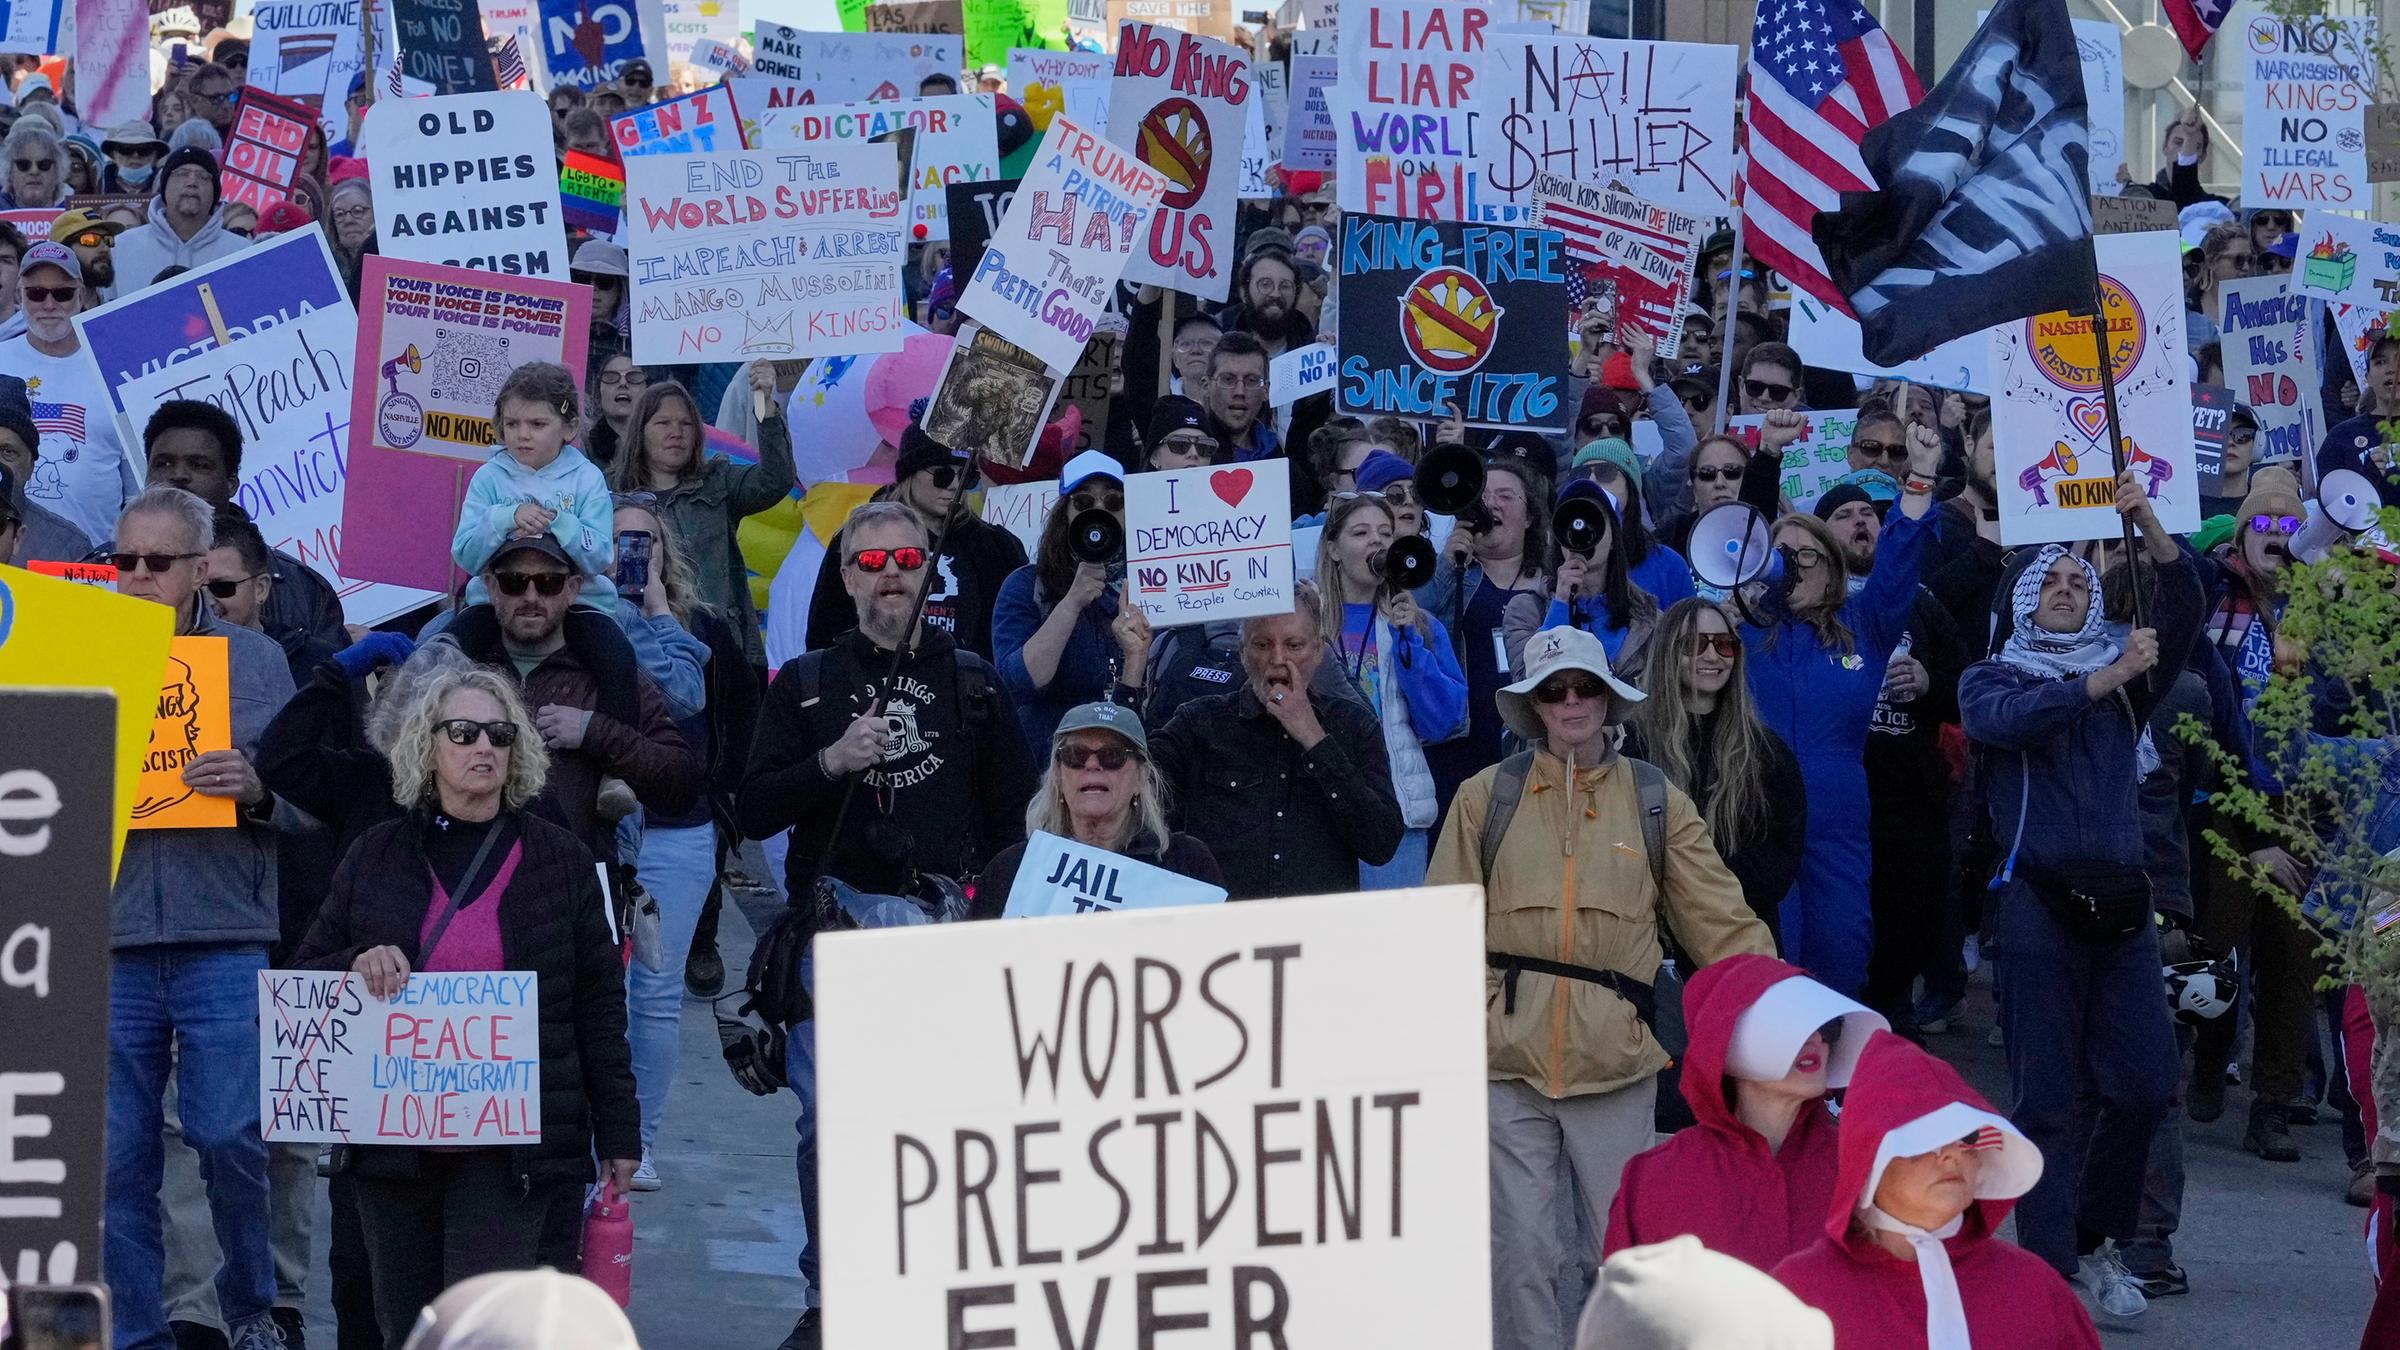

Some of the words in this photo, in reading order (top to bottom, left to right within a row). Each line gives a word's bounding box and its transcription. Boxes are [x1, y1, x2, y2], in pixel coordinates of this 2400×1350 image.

[431, 15, 461, 42] NO
[1370, 8, 1488, 52] LIAR
[2282, 23, 2338, 53] NO
[762, 37, 801, 58] MAKE
[1113, 24, 1170, 78] NO
[1171, 33, 1249, 105] KING
[81, 62, 147, 78] FAMES
[1368, 61, 1474, 108] LIAR
[2256, 60, 2360, 82] NARCISSISTIC
[2265, 82, 2358, 112] KINGS
[239, 108, 303, 151] END
[418, 109, 495, 136] OLD
[616, 103, 682, 147] GEN
[691, 94, 714, 125] Z
[804, 110, 947, 140] DICTATOR
[1352, 111, 1463, 156] WORL
[2281, 117, 2328, 143] NO
[232, 143, 284, 183] OIL
[393, 155, 535, 189] HIPPIES
[687, 160, 763, 192] END
[776, 156, 840, 182] THE
[1046, 154, 1062, 174] A
[1055, 117, 1167, 206] TRUMP?
[2263, 148, 2339, 168] ILLEGAL
[566, 182, 616, 203] RIGHTS
[567, 170, 616, 190] LGBTQ+
[1366, 156, 1464, 223] FIR
[2260, 172, 2352, 203] WARS
[392, 202, 548, 237] AGAINST
[640, 194, 767, 233] WORLD
[1538, 173, 1573, 203] SCHOOL
[1576, 185, 1600, 211] KIDS
[1649, 208, 1667, 230] DIE
[1668, 212, 1696, 235] HERE
[2100, 198, 2157, 213] ACTION
[1027, 191, 1137, 253] HA!
[637, 236, 796, 286] IMPEACH
[813, 231, 901, 260] ARREST
[1149, 208, 1217, 278] U.S.
[1342, 215, 1566, 285] KING-FREE
[1605, 231, 1624, 250] OR
[1623, 241, 1642, 261] IN
[1641, 251, 1675, 283] IRAN
[387, 289, 431, 306] YOUR
[434, 296, 481, 313] VOICE
[483, 303, 500, 316] IS
[503, 304, 563, 325] POWER
[388, 276, 433, 294] YOUR
[435, 283, 482, 300] VOICE
[484, 290, 501, 301] IS
[504, 291, 564, 312] POWER
[639, 288, 744, 323] MANGO
[2223, 283, 2307, 334] America
[385, 302, 430, 319] YOUR
[433, 308, 480, 326] VOICE
[482, 315, 499, 329] IS
[501, 317, 562, 338] POWER
[1041, 288, 1094, 344] GOOD
[2039, 316, 2133, 337] NASHVLLE
[678, 326, 721, 355] NO
[2248, 335, 2288, 365] Has
[1299, 366, 1324, 386] NO
[1301, 350, 1327, 369] NO
[387, 396, 418, 413] SINGING
[1342, 355, 1461, 419] SINCE
[1469, 372, 1559, 423] 1776
[2247, 372, 2298, 406] NO
[382, 422, 419, 445] RESISTANCE
[383, 412, 420, 424] NASHVILLE
[426, 413, 450, 437] NO
[453, 417, 497, 445] KING
[239, 411, 350, 522] onvict
[1166, 479, 1180, 514] I
[2059, 483, 2082, 506] NO
[2086, 480, 2115, 505] KIN
[1136, 515, 1267, 553] DEMOCRACY
[1138, 567, 1168, 587] NO
[1177, 559, 1231, 585] KING
[1248, 555, 1268, 580] IN
[922, 605, 957, 617] MEN'S
[882, 675, 936, 705] INGS
[1193, 667, 1230, 683] PRESS
[1887, 712, 1909, 727] ICE
[1046, 852, 1123, 904] JAIL
[272, 976, 363, 1017] KINGS
[388, 974, 532, 1008] DEMOCRACY
[275, 1017, 353, 1055] WAR
[385, 1012, 513, 1061] PEACE
[1003, 943, 1302, 1102] WORST
[270, 1055, 333, 1094] ICE
[373, 1054, 419, 1089] LOVE
[424, 1059, 538, 1093] IMMIGRANT
[273, 1097, 351, 1133] HATE
[377, 1091, 461, 1140] LOVE
[473, 1093, 543, 1137] ALL
[894, 1091, 1420, 1276] PRESIDENT
[945, 1265, 1291, 1350] EVER
